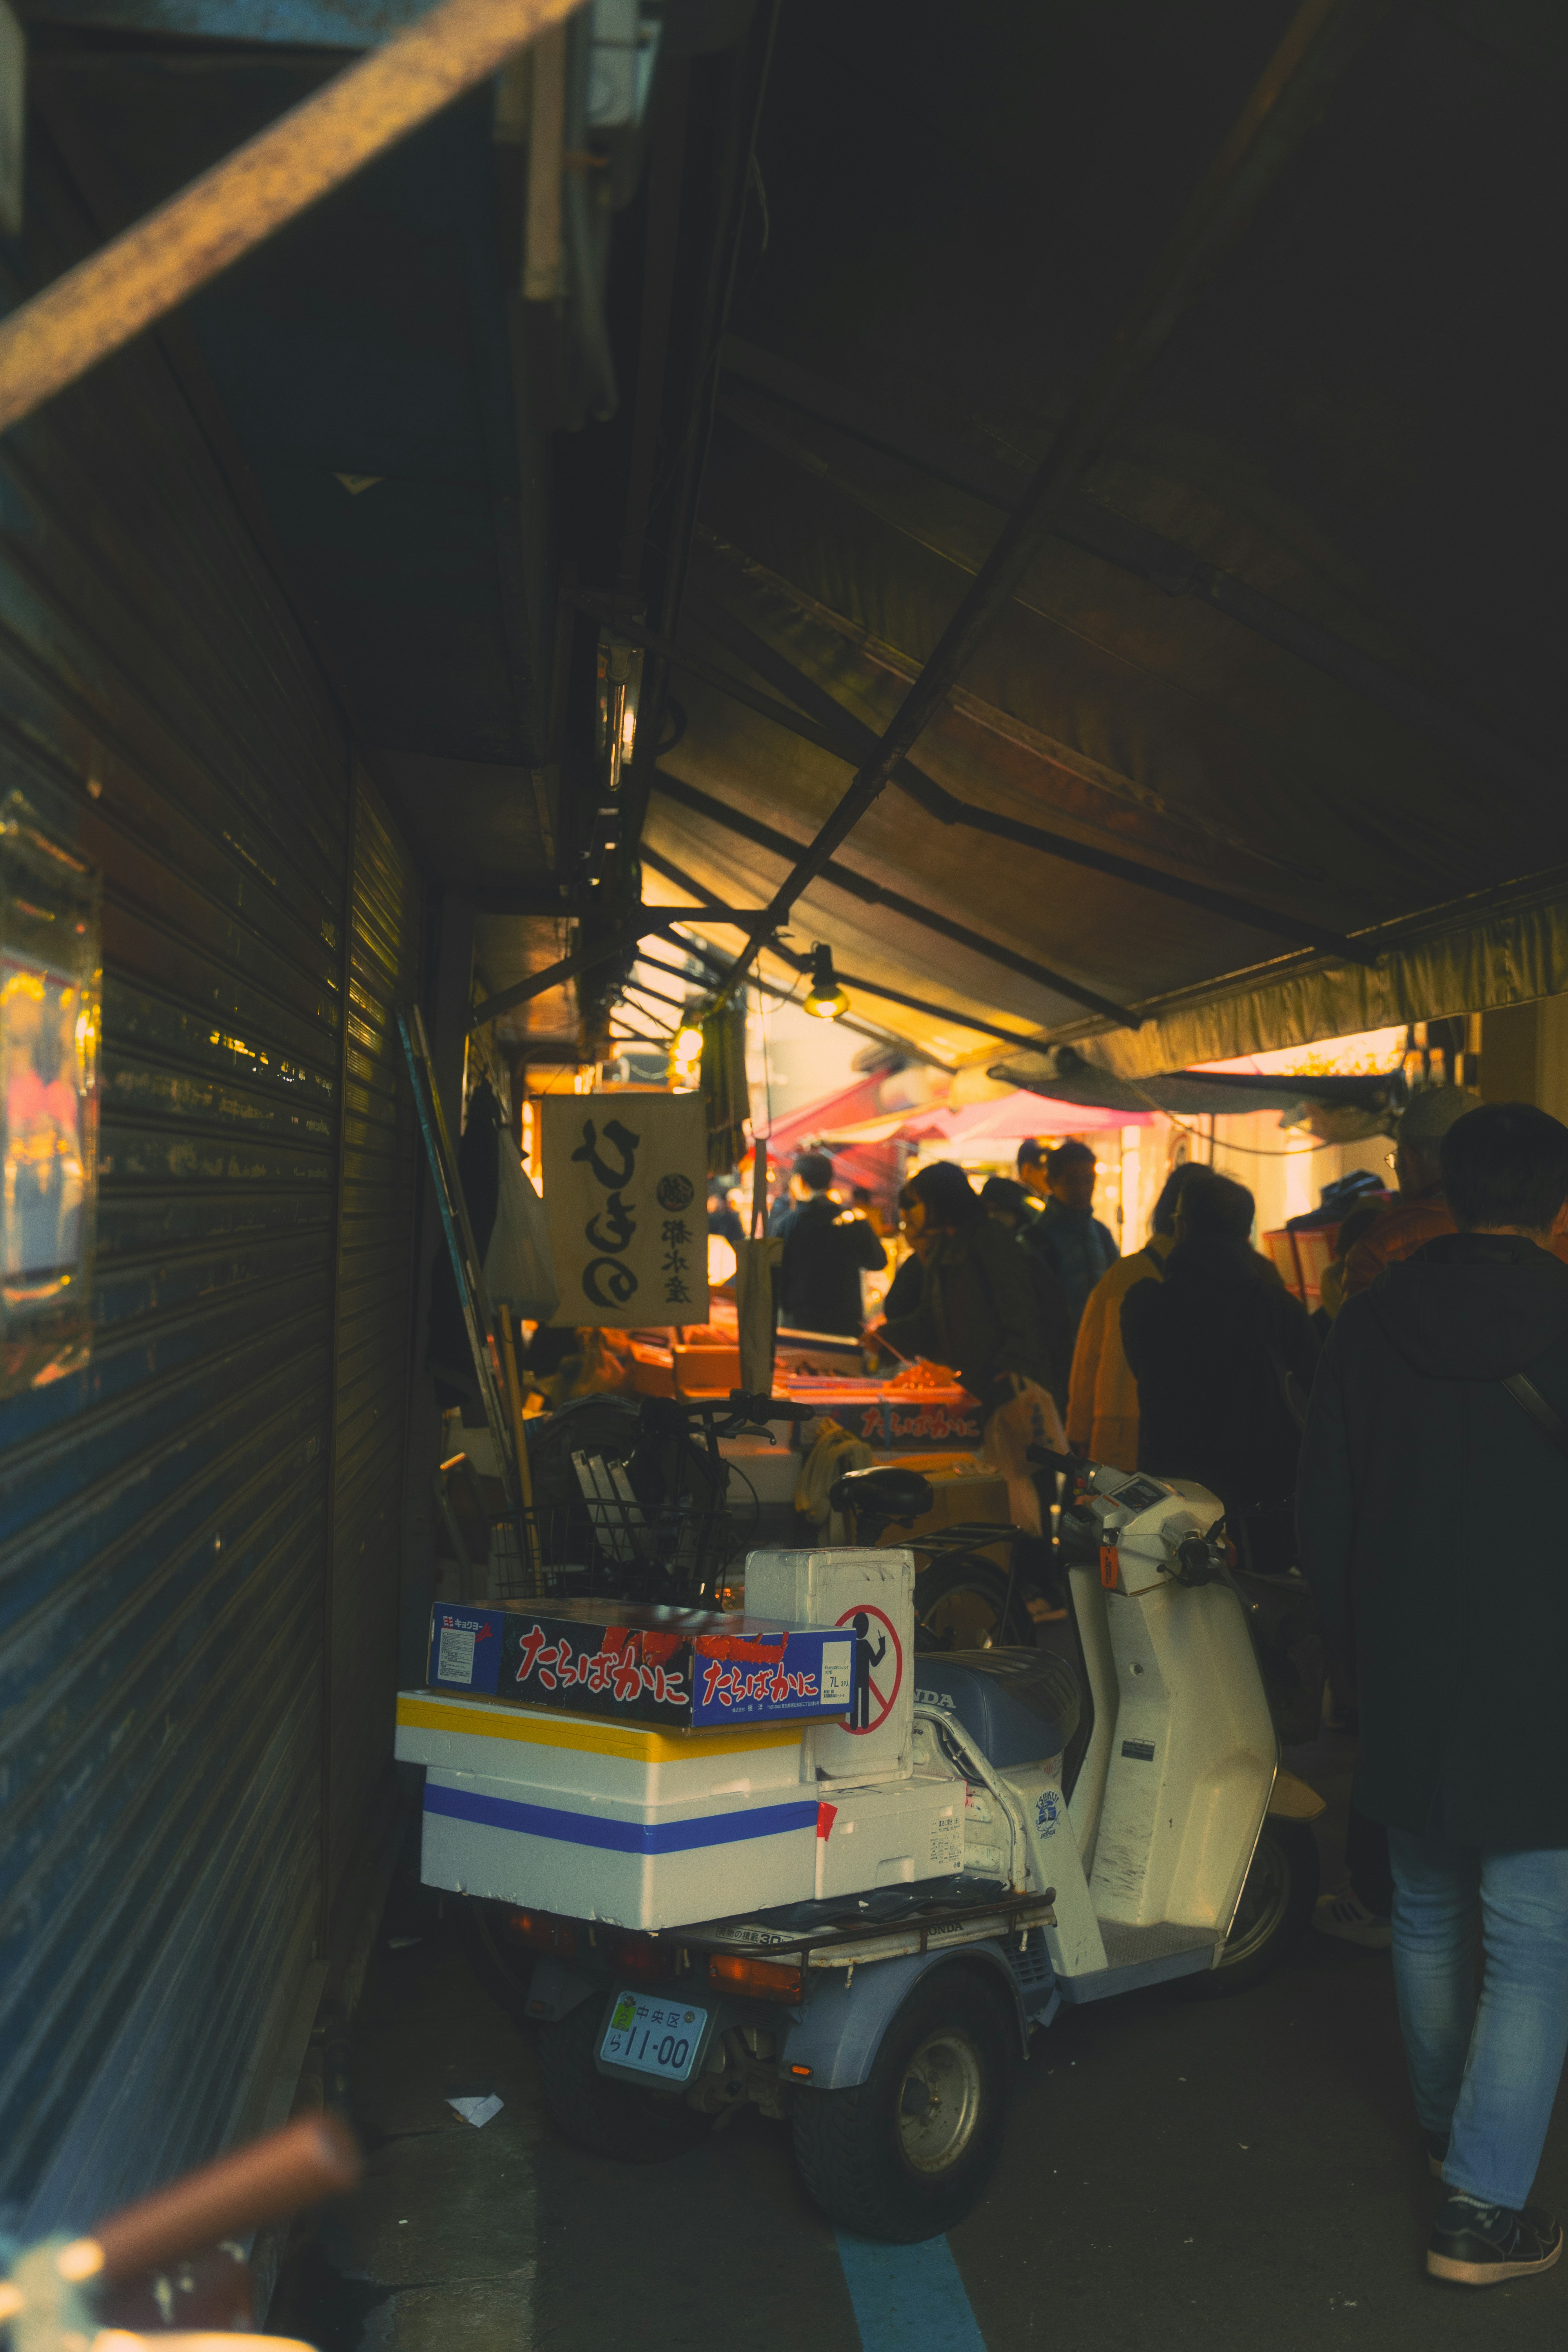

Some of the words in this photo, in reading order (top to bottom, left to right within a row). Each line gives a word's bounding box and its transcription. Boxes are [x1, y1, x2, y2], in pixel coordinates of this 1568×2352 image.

[517, 1624, 689, 1704] たらばかに
[702, 1660, 818, 1706] たらばかに
[830, 1677, 838, 1687] 7L
[914, 1688, 956, 1709] NDA
[1036, 1791, 1059, 1809] TSUKIJI
[1040, 1829, 1056, 1839] JAPAN
[719, 1927, 759, 1942] 荷物の積載
[920, 1921, 964, 1936] ONDA
[636, 2005, 680, 2028] 中央区
[610, 2034, 621, 2052] ら
